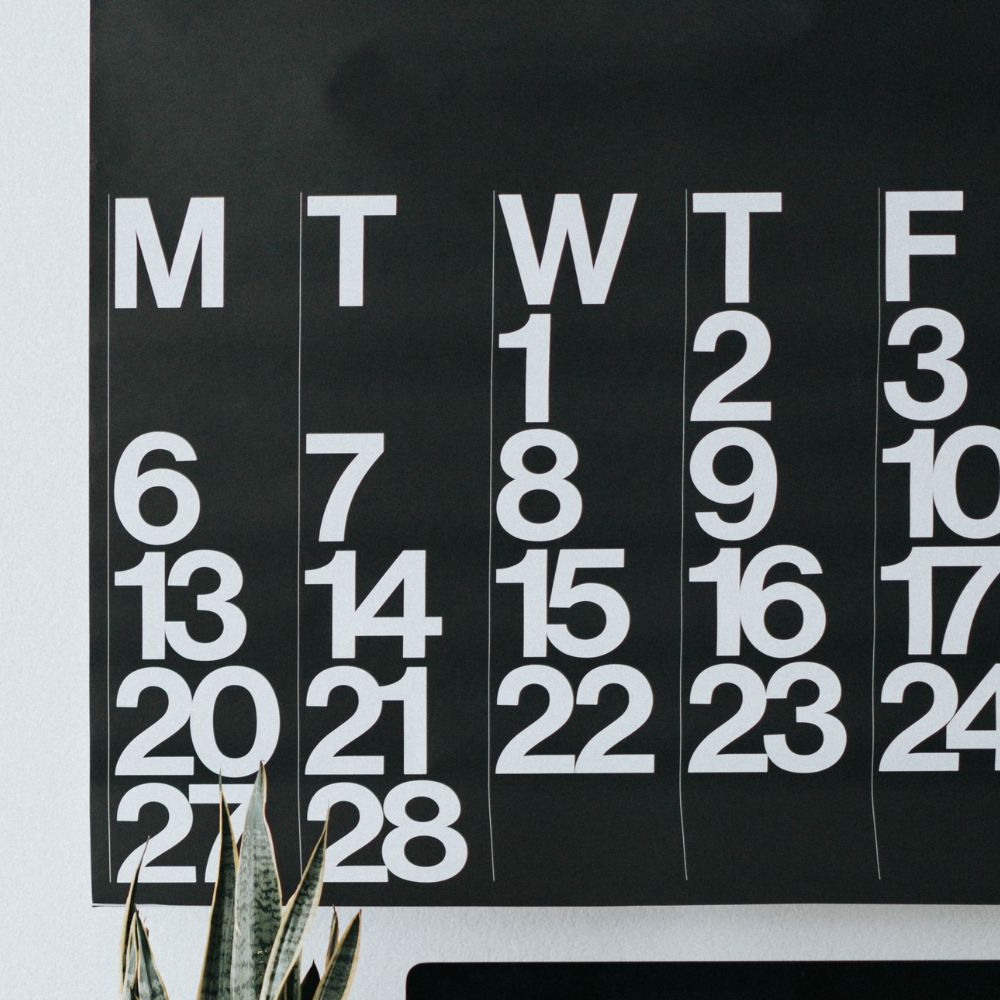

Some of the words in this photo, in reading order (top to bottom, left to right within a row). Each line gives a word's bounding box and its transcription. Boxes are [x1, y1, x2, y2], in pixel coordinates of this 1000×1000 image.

[114, 196, 225, 309] M
[306, 194, 397, 307] T
[498, 193, 638, 306] W
[692, 192, 783, 304] T
[885, 190, 964, 302] F
[498, 313, 551, 423] 1
[690, 310, 772, 422] 2
[883, 307, 968, 421] 3
[113, 431, 201, 546] 6
[305, 432, 385, 542] 7
[495, 428, 583, 542] 8
[689, 426, 778, 541] 9
[882, 424, 1000, 539] 10
[114, 549, 247, 662] 13
[304, 549, 443, 659] 14
[495, 548, 631, 659] 15
[688, 544, 827, 659] 16
[880, 545, 1000, 655] 17
[114, 665, 281, 778] 20
[304, 665, 428, 776] 21
[495, 663, 655, 775] 22
[687, 661, 847, 774] 23
[878, 661, 1000, 772] 24
[116, 782, 256, 884] 27
[306, 779, 468, 883] 28
